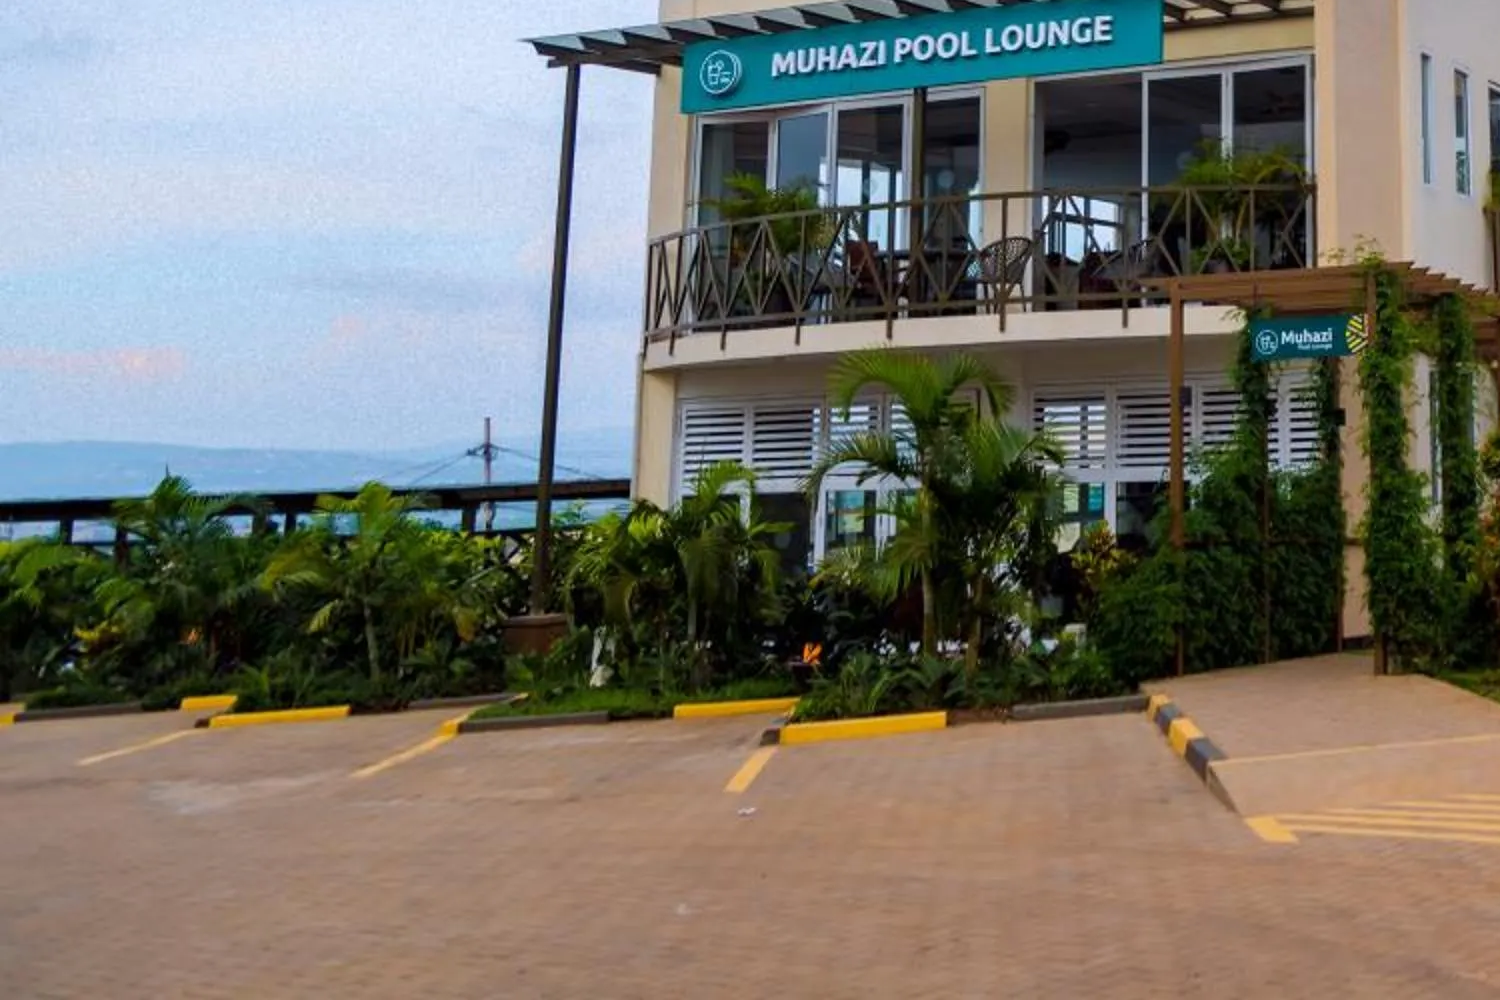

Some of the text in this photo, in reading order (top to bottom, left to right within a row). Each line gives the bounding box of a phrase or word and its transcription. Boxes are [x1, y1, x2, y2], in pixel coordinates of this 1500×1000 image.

[771, 15, 1113, 77] MUHAZI POOL LOUNGE
[1281, 327, 1333, 345] Muhazi
